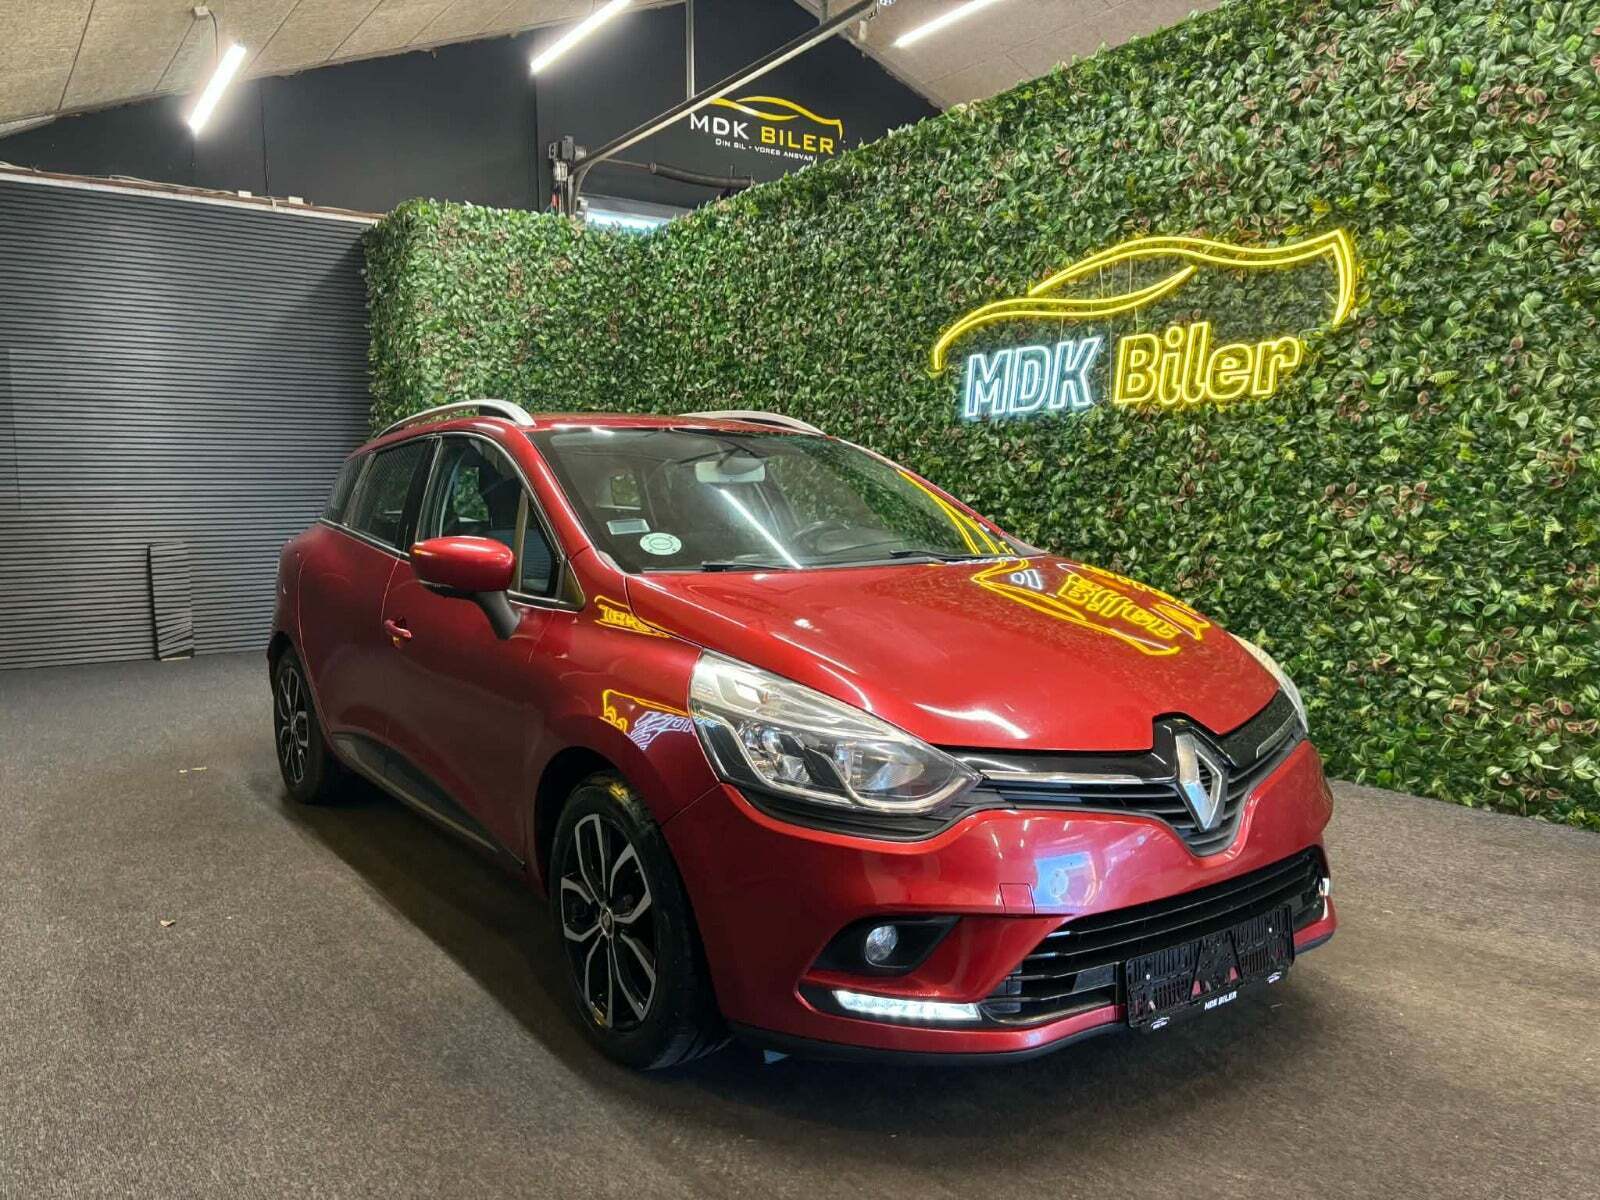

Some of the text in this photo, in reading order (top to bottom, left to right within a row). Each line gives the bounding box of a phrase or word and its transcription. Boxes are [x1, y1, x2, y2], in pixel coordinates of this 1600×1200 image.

[690, 112, 833, 155] MDK BILER
[715, 138, 731, 147] DIN
[754, 146, 781, 156] VORES
[783, 151, 813, 161] ANSVAR
[964, 321, 1302, 418] MDK Biler
